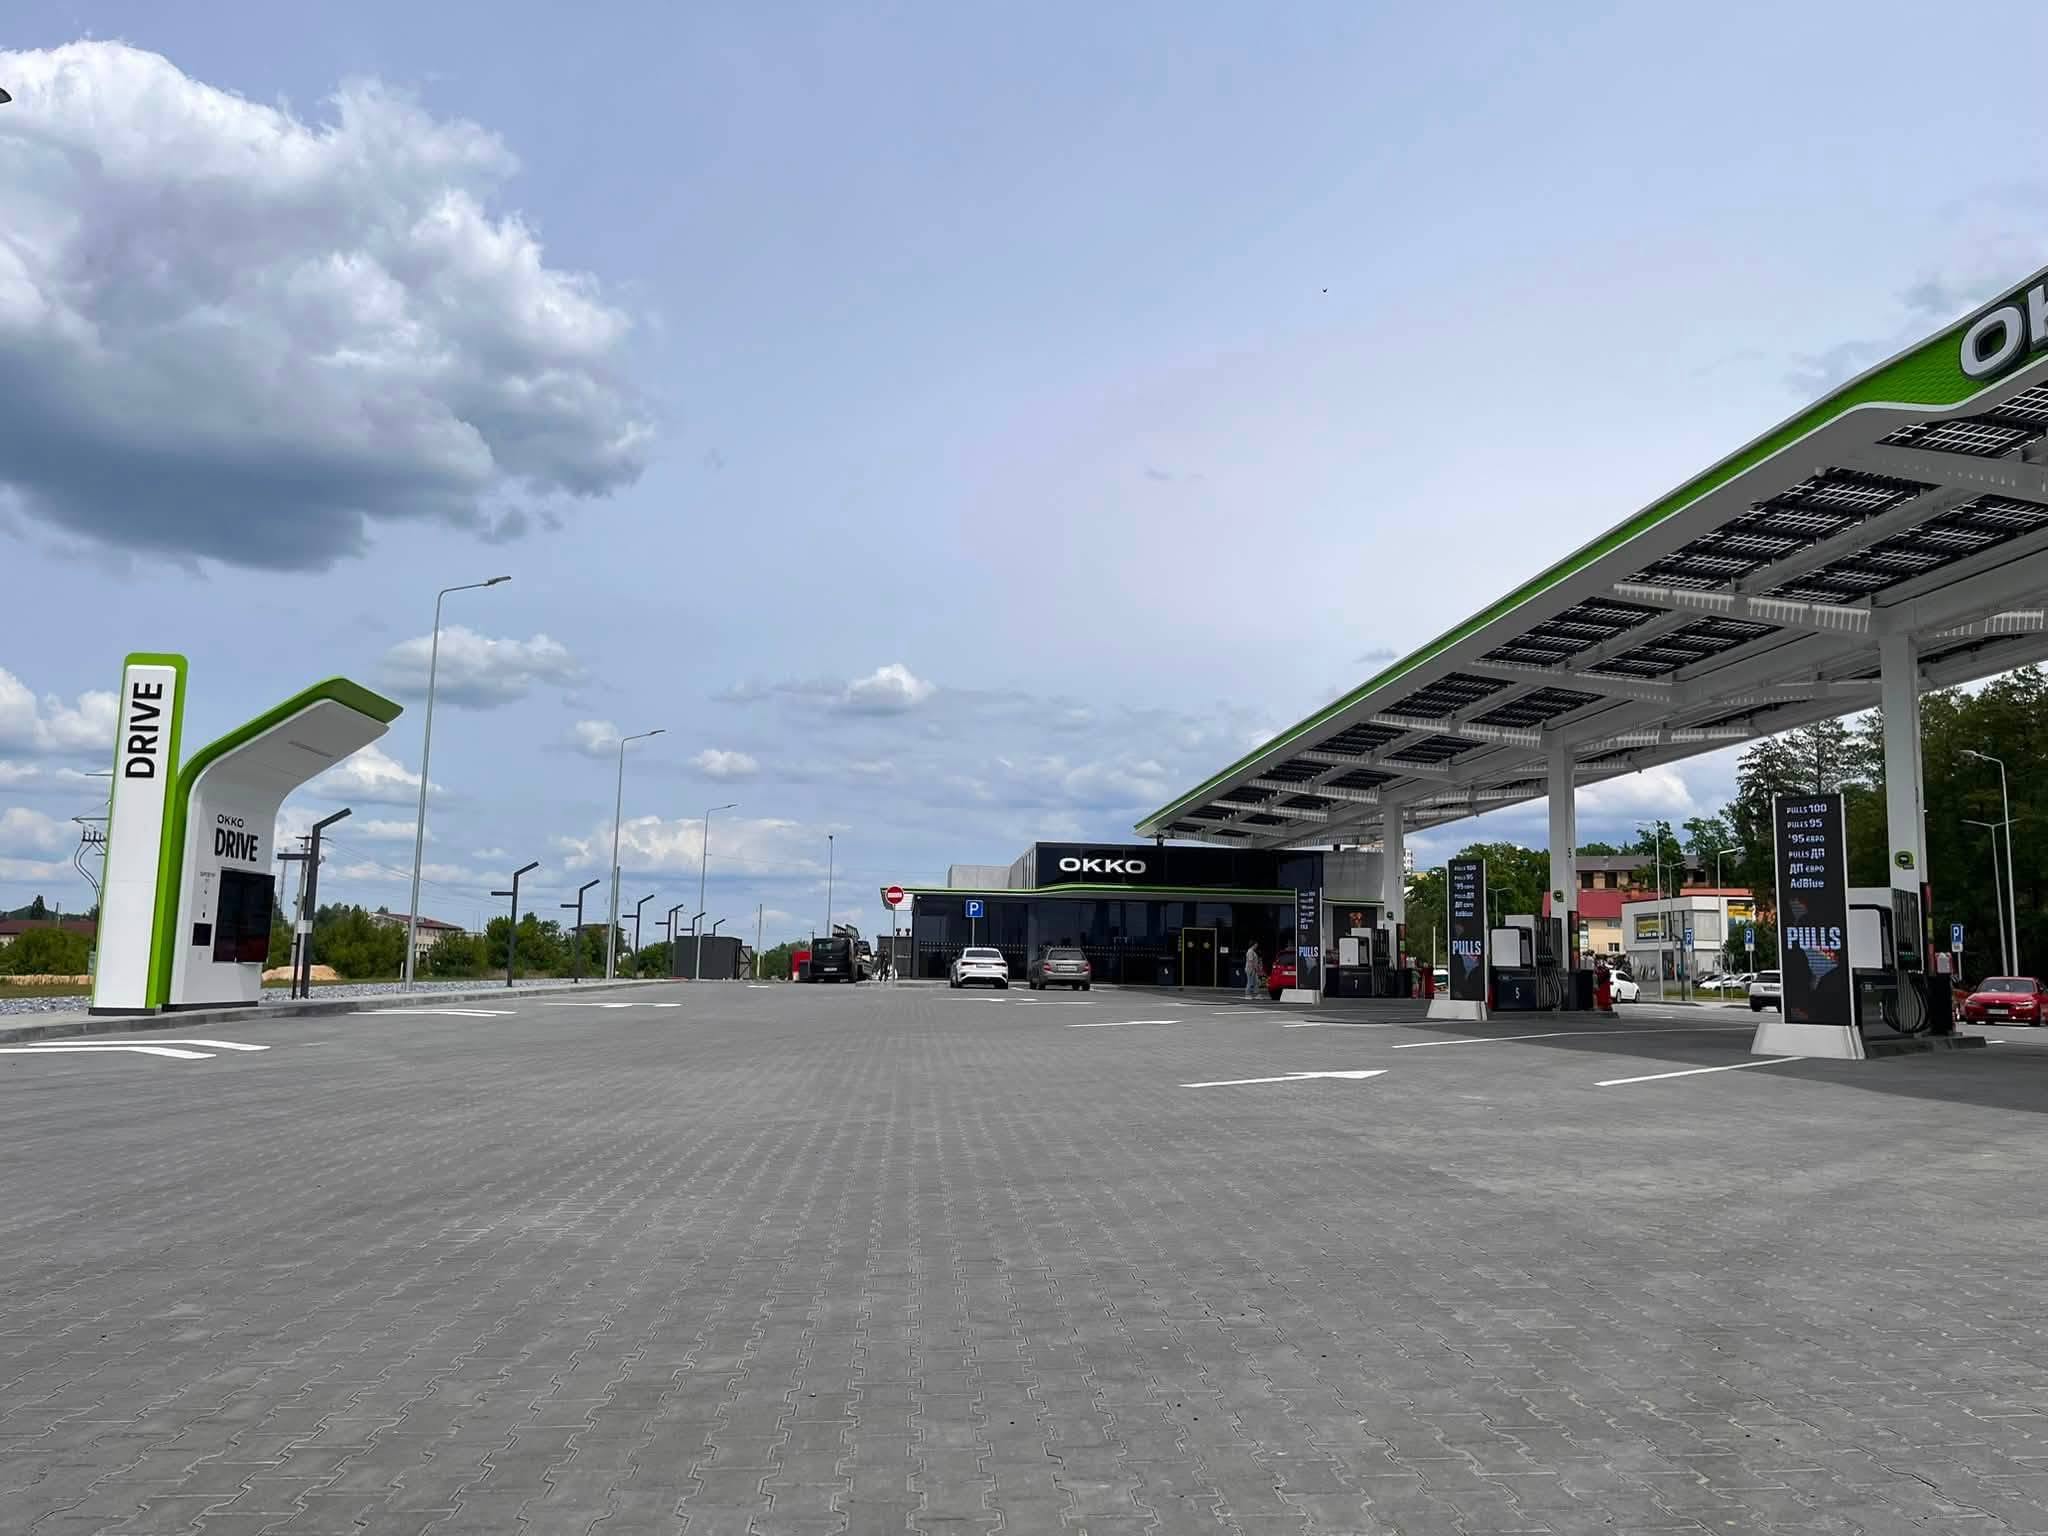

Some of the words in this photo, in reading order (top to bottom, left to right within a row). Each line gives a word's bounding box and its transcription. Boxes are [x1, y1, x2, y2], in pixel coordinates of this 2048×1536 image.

[125, 683, 162, 778] DRIVE
[1786, 806, 1808, 814] PULLS
[1808, 803, 1828, 813] 100
[217, 814, 244, 828] OKKO
[1787, 821, 1809, 829] PULLS
[1809, 818, 1823, 828] 95
[214, 827, 258, 862] DRIVE
[1788, 850, 1810, 858] PULLS
[1810, 848, 1825, 860] ДП
[1059, 857, 1146, 874] OKKO
[1789, 863, 1804, 875] ДП
[1790, 878, 1825, 889] AdBlue
[969, 902, 979, 916] P
[1786, 926, 1841, 950] PULLS
[1953, 926, 1960, 941] P
[1299, 946, 1319, 957] PULLS
[1453, 941, 1481, 955] PULLS
[1515, 987, 1520, 999] 5
